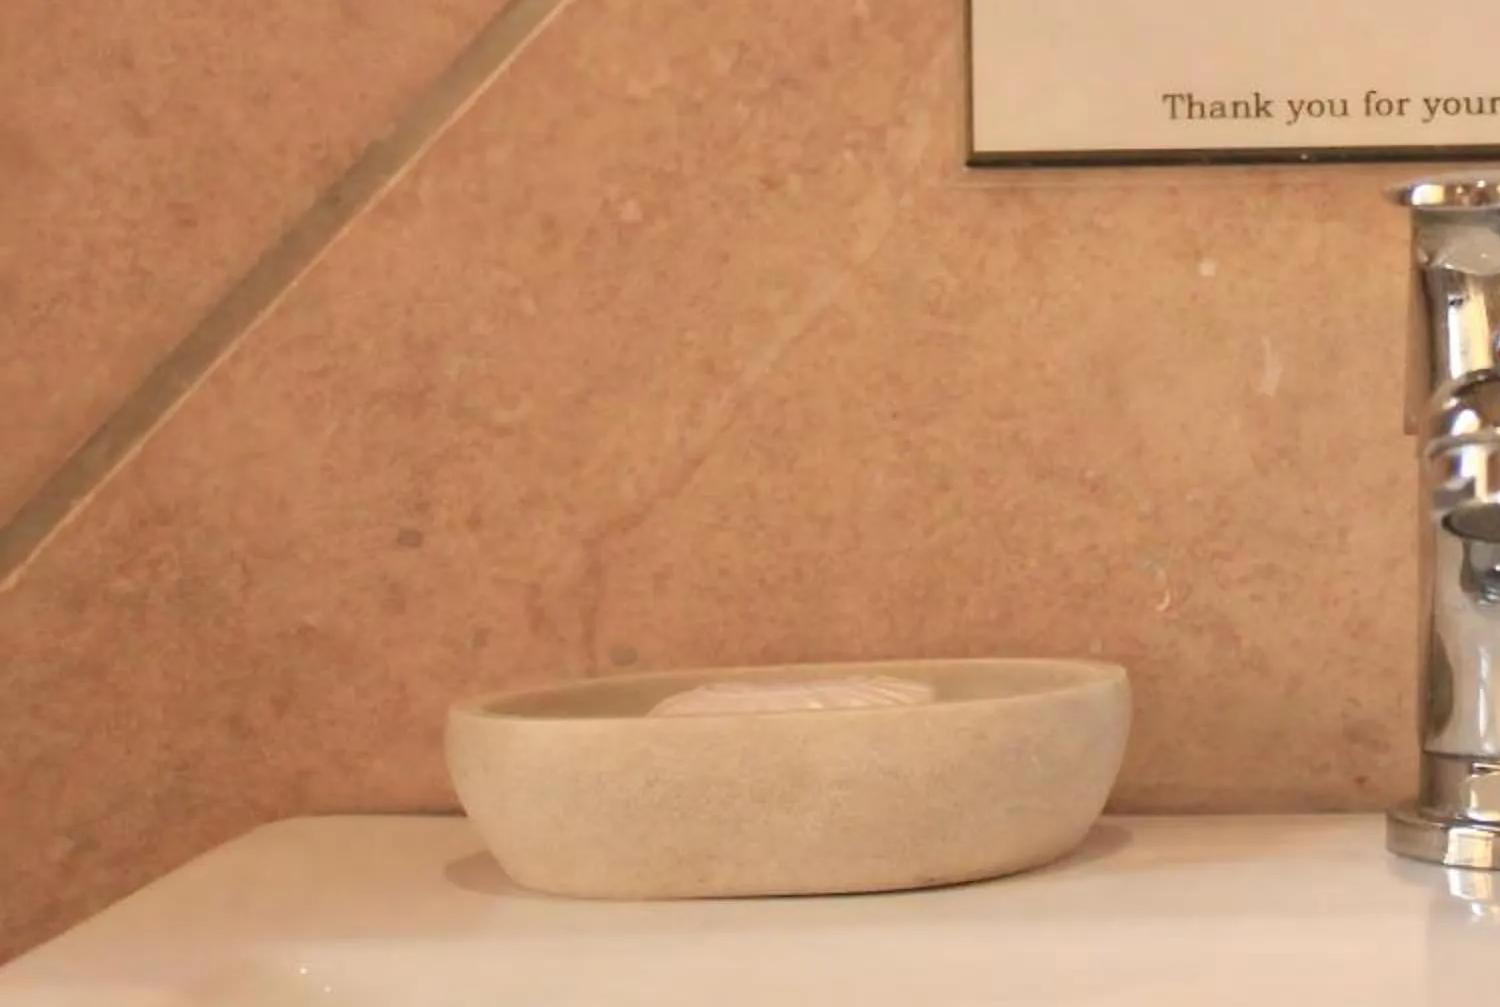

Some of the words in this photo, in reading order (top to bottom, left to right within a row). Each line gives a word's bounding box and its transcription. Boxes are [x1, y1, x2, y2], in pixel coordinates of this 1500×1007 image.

[1161, 90, 1275, 121] Thank
[1285, 98, 1350, 126] you
[1363, 89, 1412, 118] for
